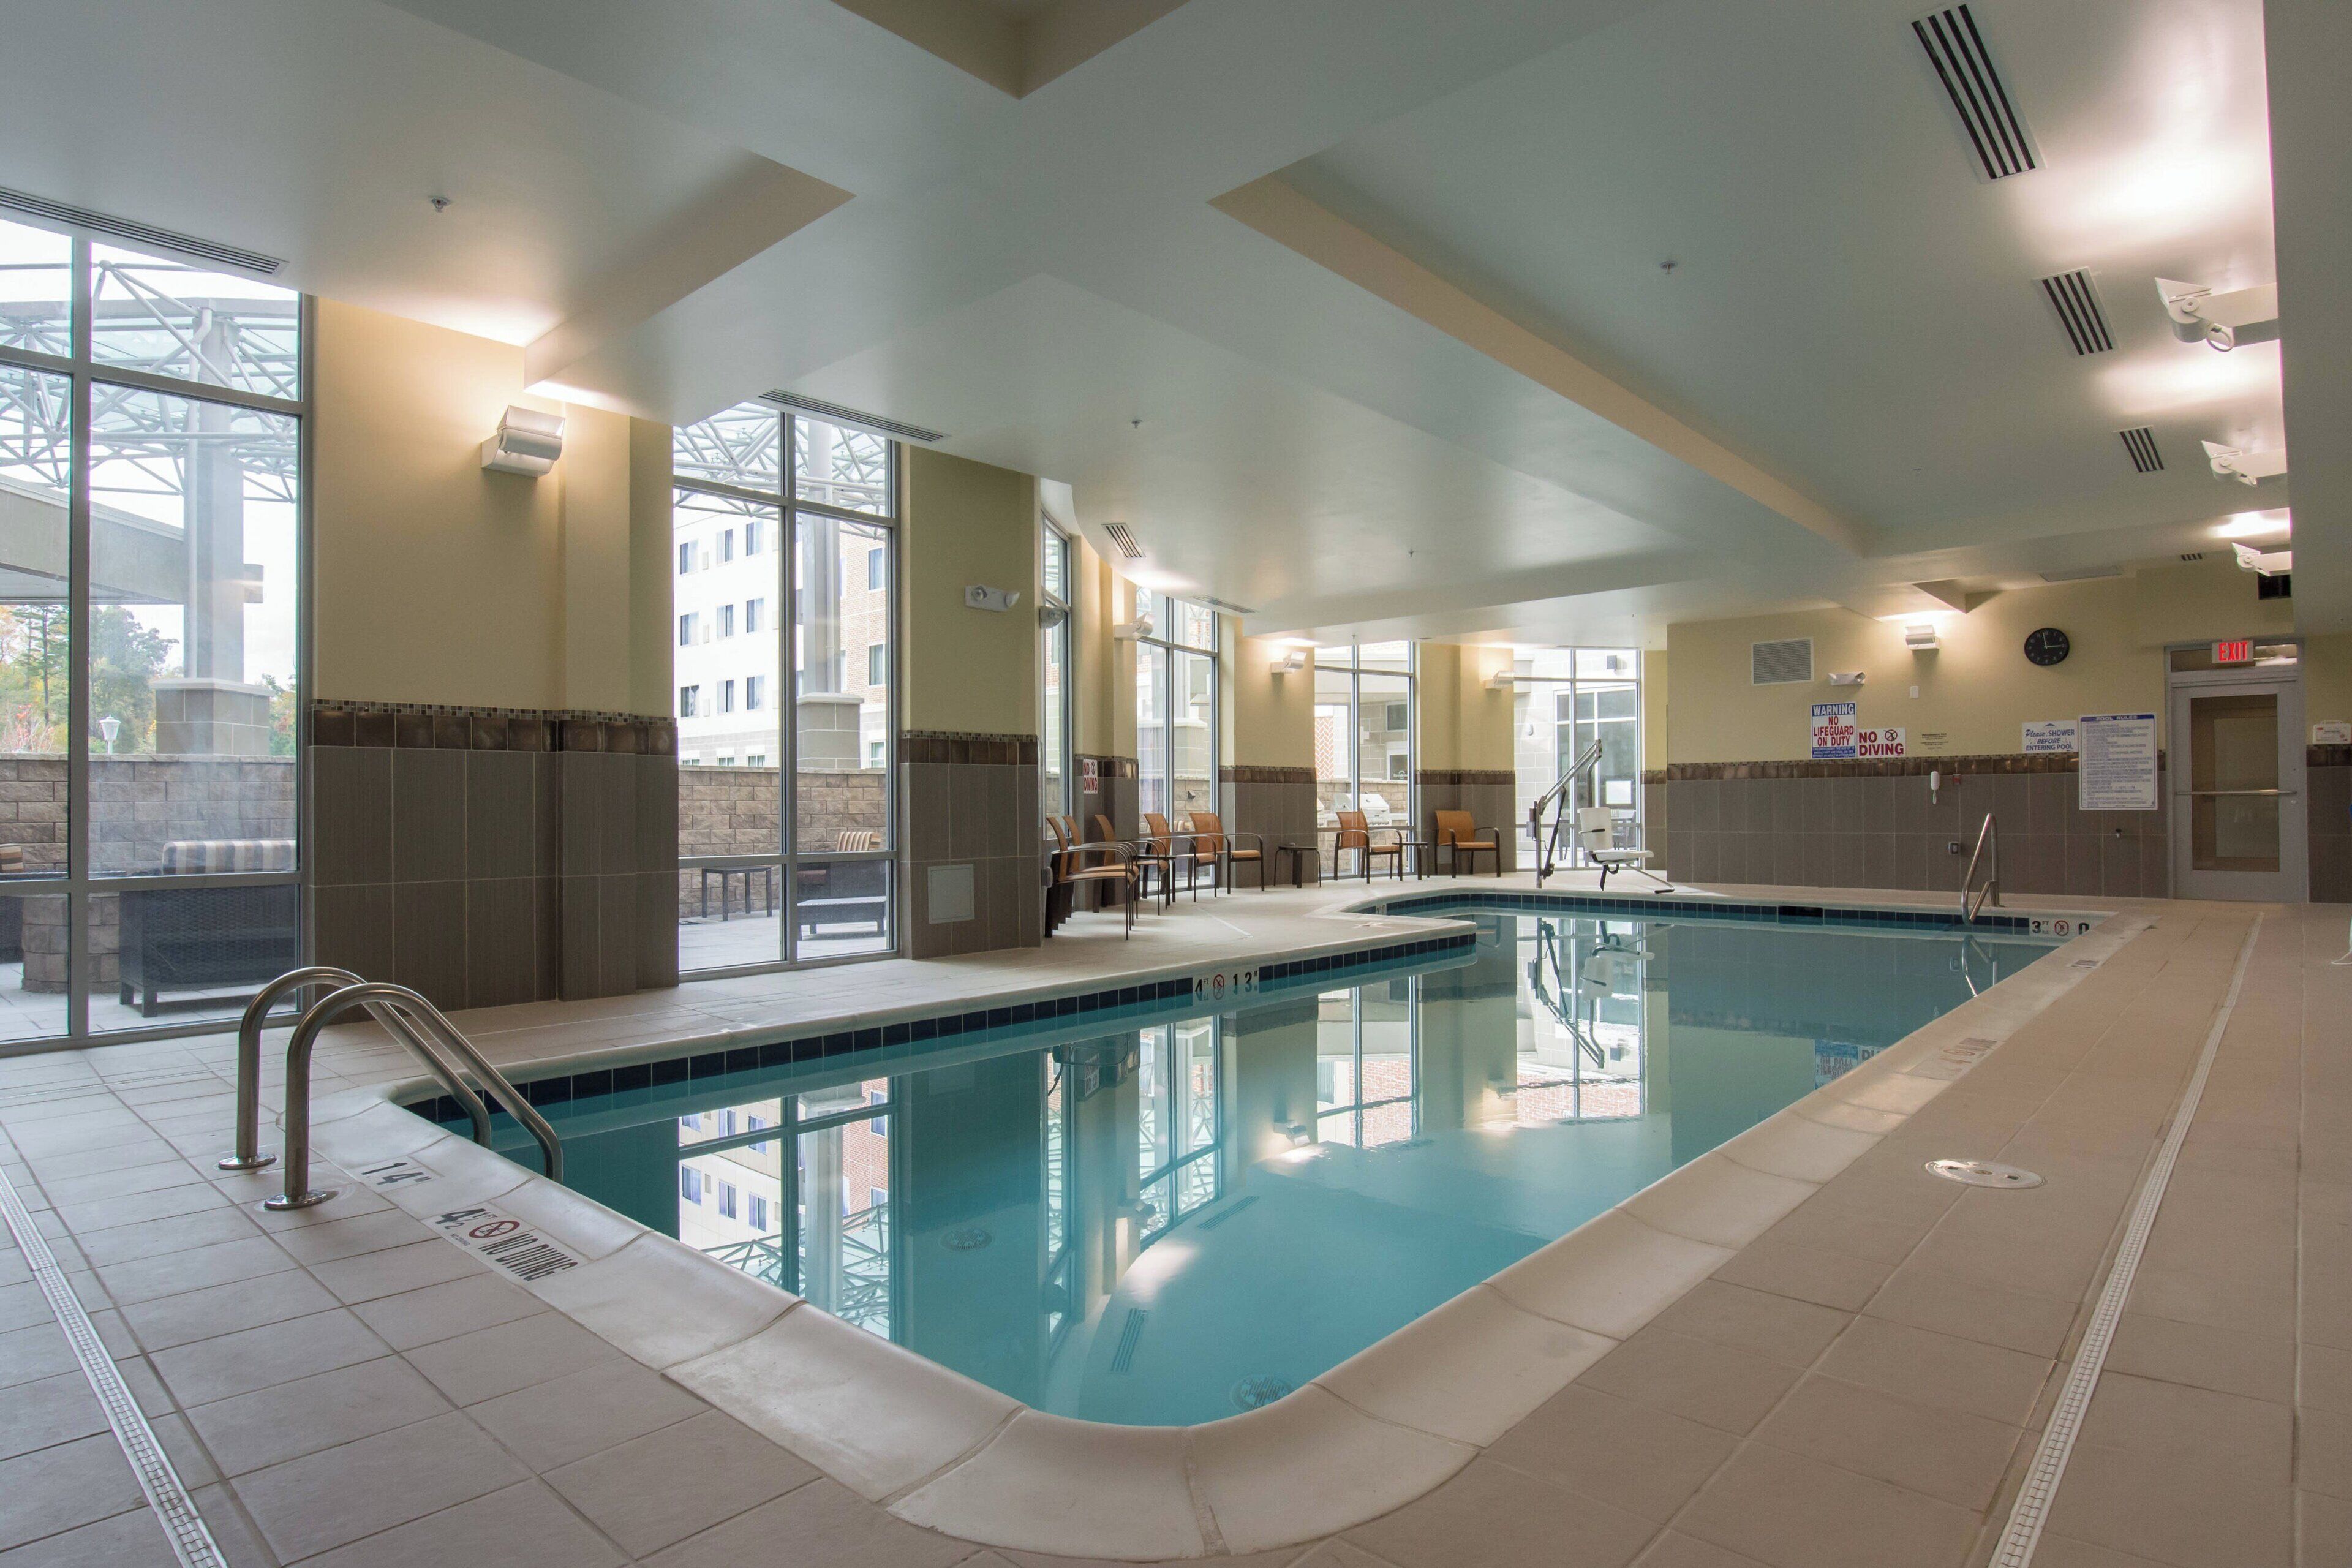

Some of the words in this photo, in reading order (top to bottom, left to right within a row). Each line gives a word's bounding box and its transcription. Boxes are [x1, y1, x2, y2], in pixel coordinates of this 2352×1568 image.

[2219, 641, 2248, 661] EXIT
[1813, 704, 1854, 715] WARNING
[1828, 716, 1839, 726] NO
[1813, 725, 1854, 736] LIFEGUARD
[2025, 729, 2045, 737] Please
[1817, 736, 1828, 747] ON
[1831, 736, 1850, 746] DUTY
[1859, 731, 1877, 744] NO
[1859, 743, 1904, 756] DIVING
[1084, 762, 1090, 775] NO
[1084, 777, 1097, 791] DIVING
[478, 1233, 539, 1255] NO
[495, 1244, 578, 1281] DIVING
